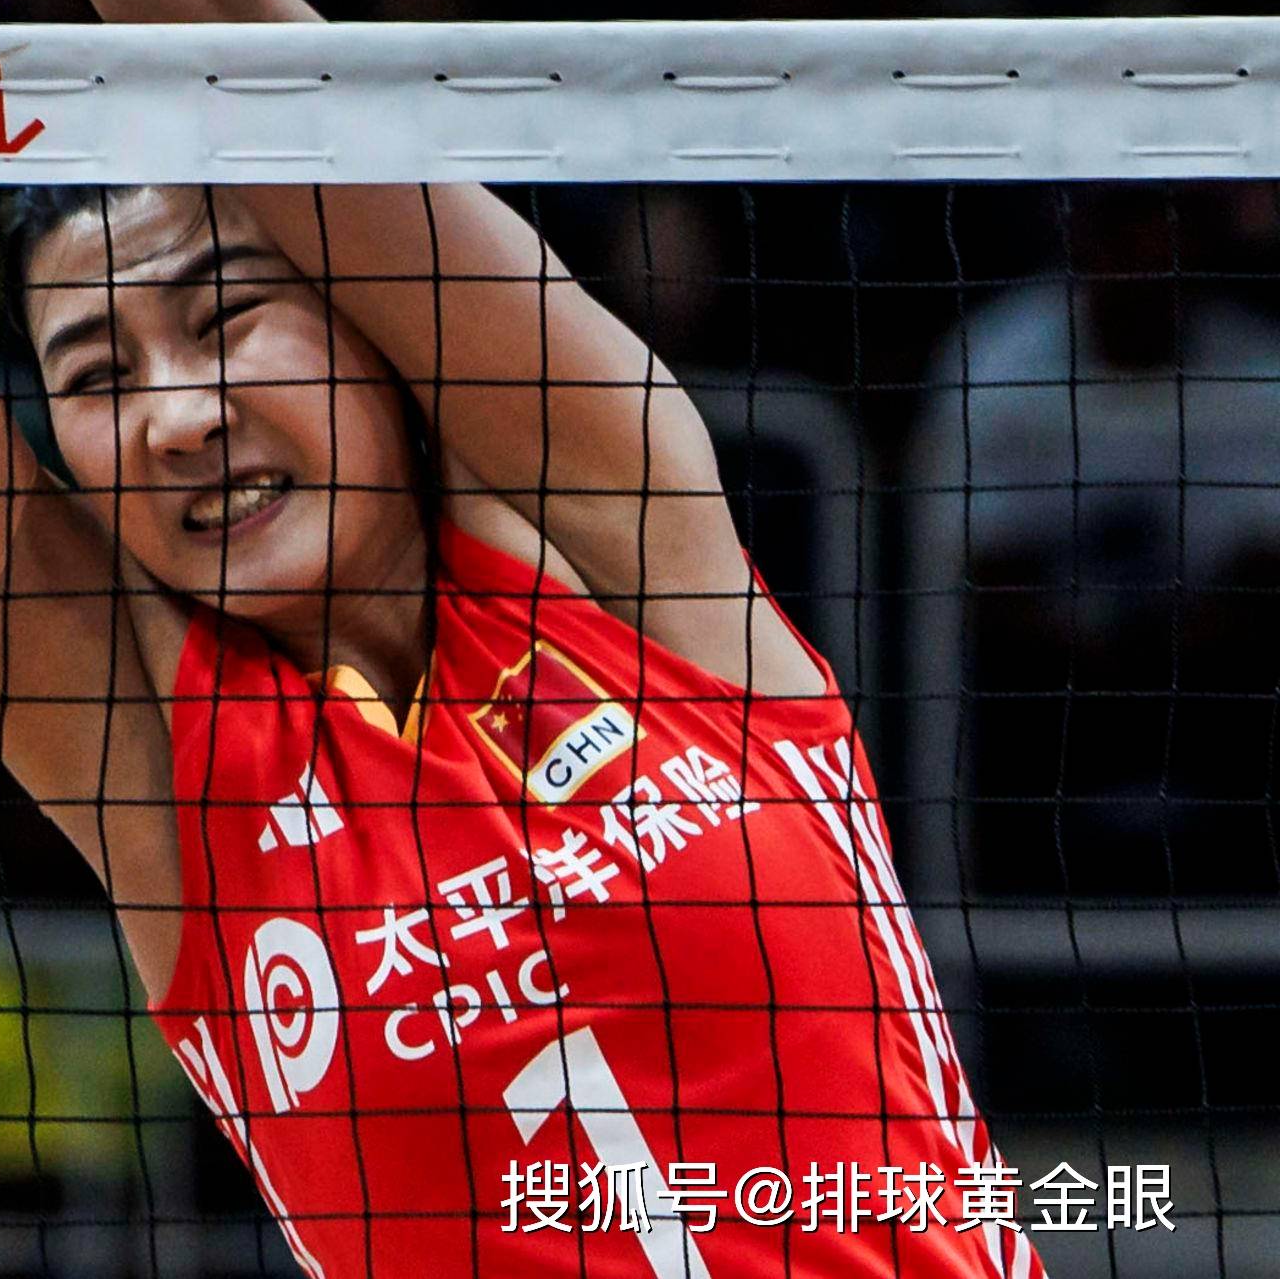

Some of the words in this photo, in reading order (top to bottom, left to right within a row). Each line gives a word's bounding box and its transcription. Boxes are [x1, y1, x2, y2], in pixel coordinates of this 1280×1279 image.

[544, 716, 625, 787] CHN
[355, 745, 761, 996] 太平洋保险
[383, 949, 570, 1061] CPIC
[502, 1025, 715, 1279] 1
